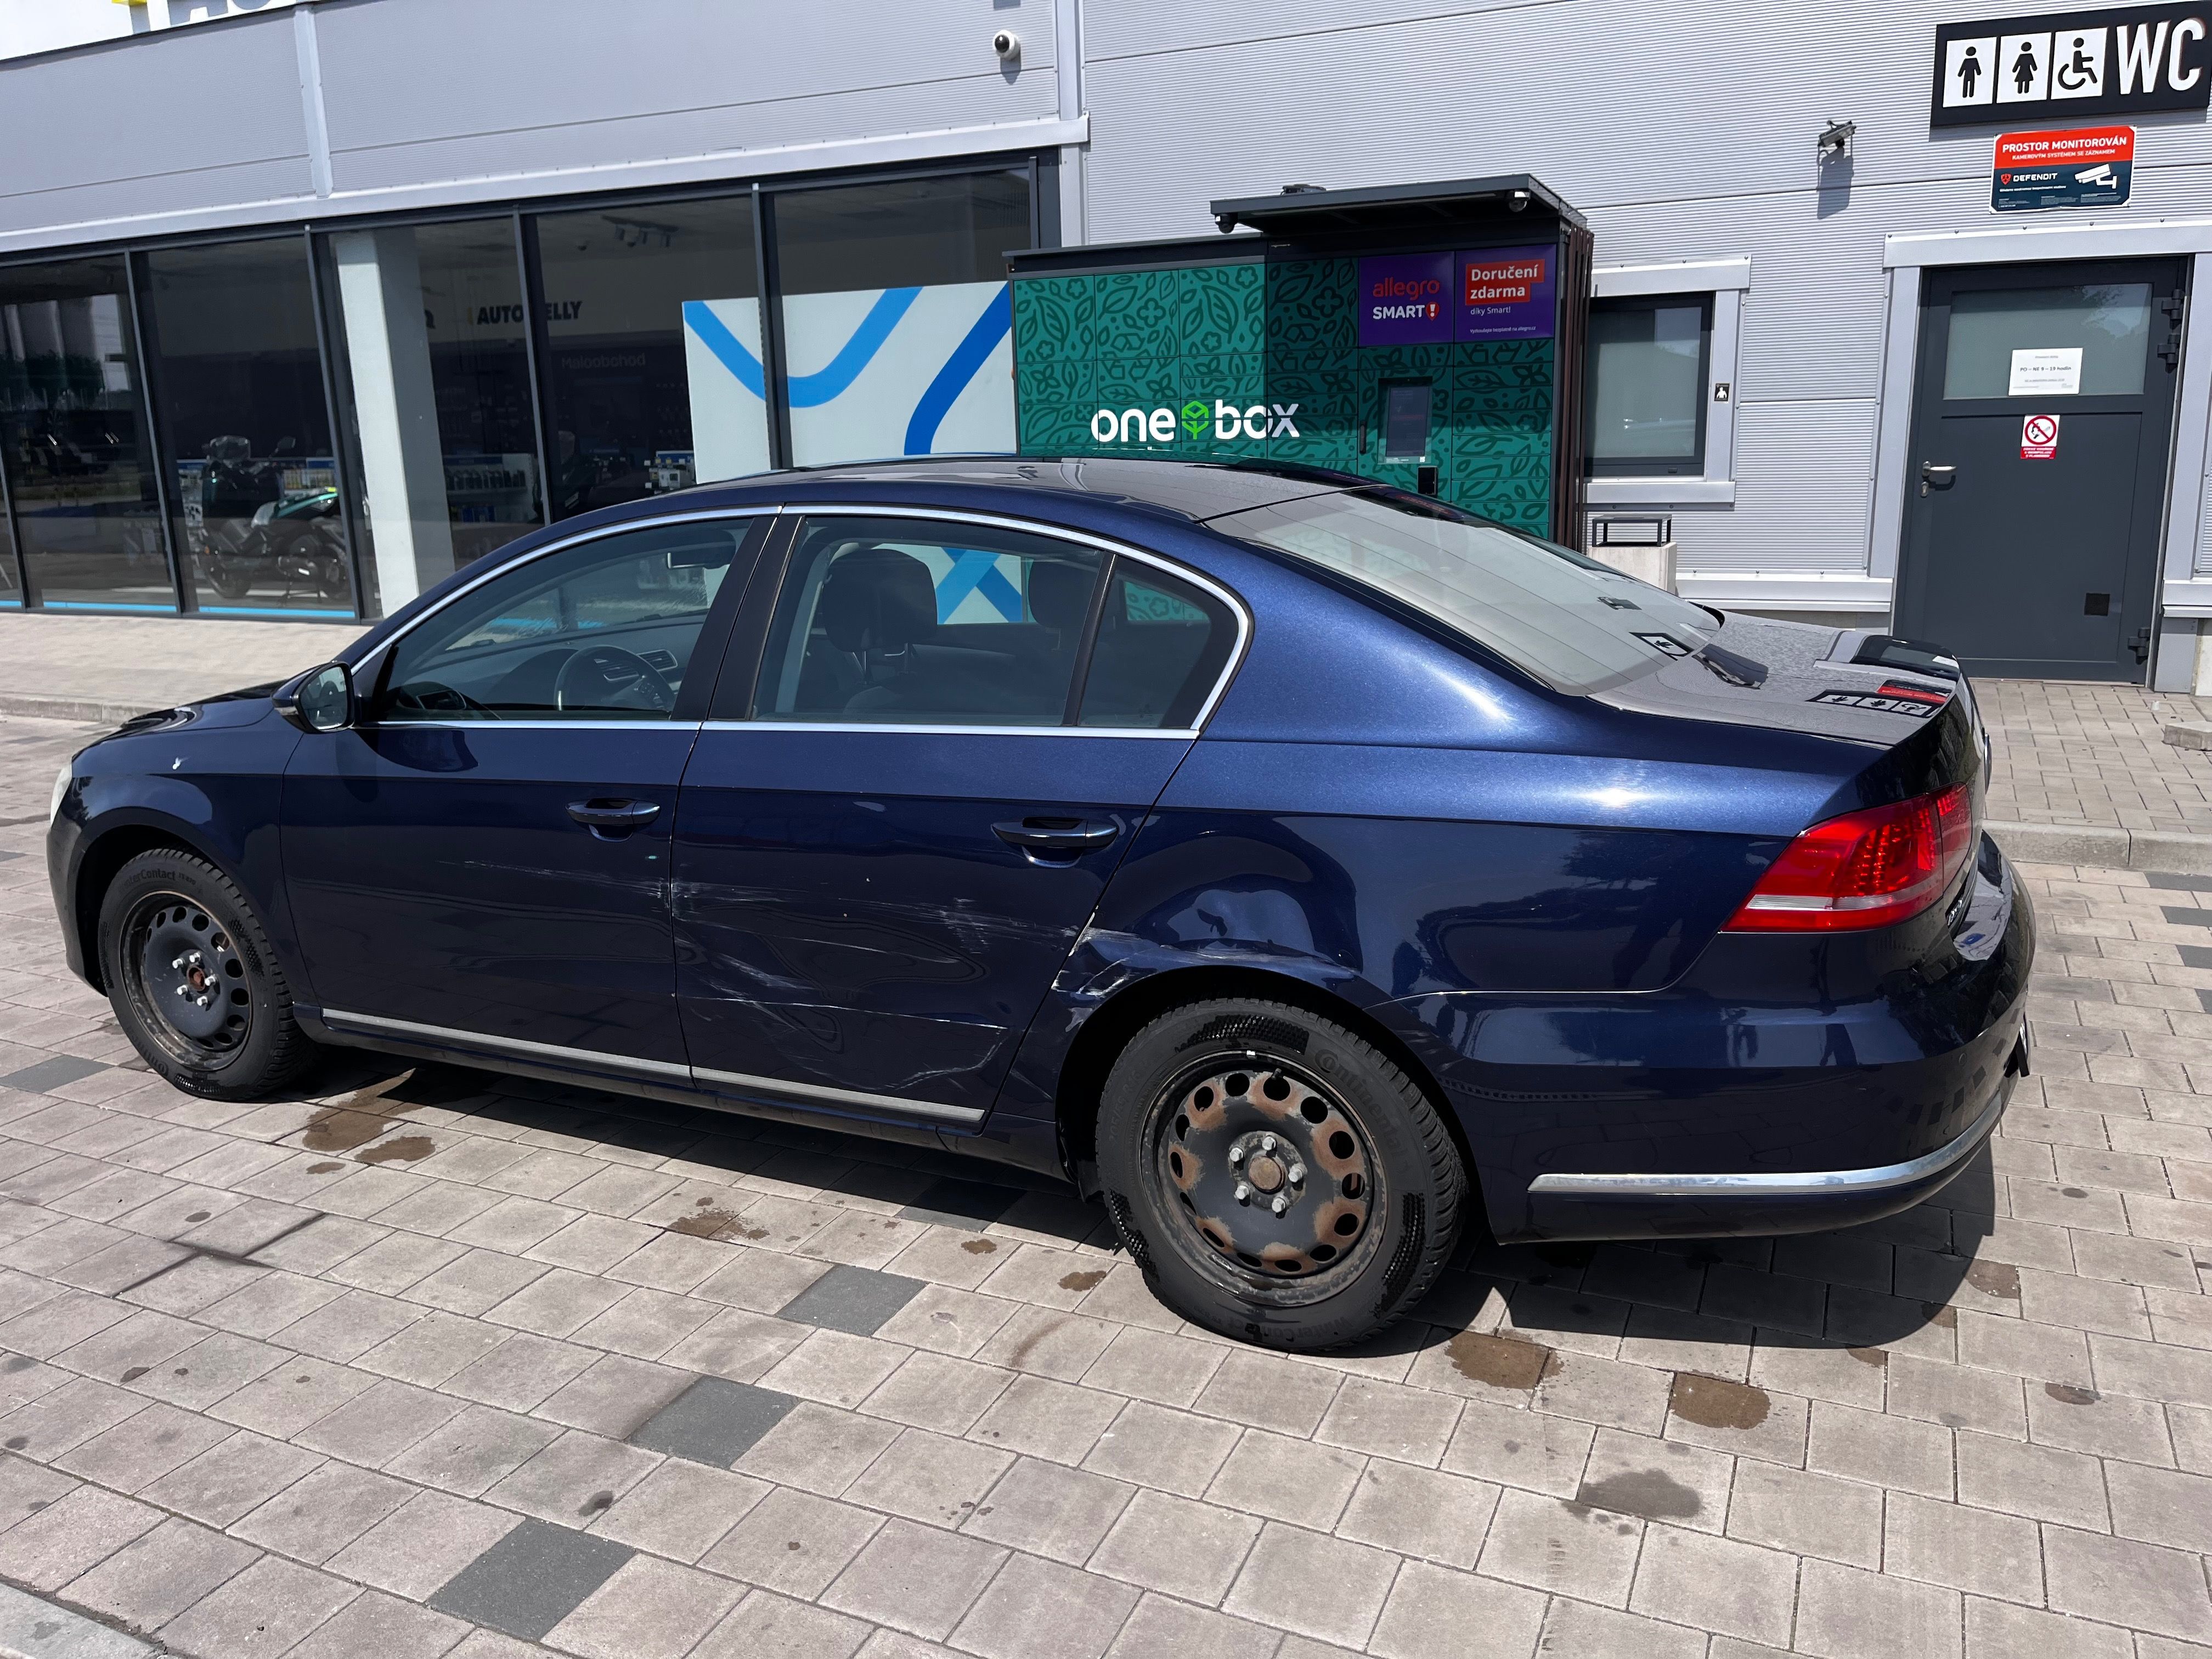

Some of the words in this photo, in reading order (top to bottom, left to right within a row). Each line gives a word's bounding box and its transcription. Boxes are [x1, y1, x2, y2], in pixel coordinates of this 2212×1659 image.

[2117, 18, 2206, 95] WC
[2002, 141, 2049, 153] PROSTOR
[2052, 135, 2127, 150] MONITOROVÁN
[2013, 173, 2058, 182] DEFENDIT
[1471, 264, 1538, 281] Doručení
[1373, 277, 1440, 301] allegro
[1470, 286, 1526, 300] zdarma
[477, 304, 524, 325] AUTO
[545, 300, 583, 320] ELLY
[1470, 307, 1486, 317] díky
[1487, 306, 1511, 314] Smart!
[561, 353, 646, 370] Maloobchod
[1091, 408, 1176, 443] one
[1215, 399, 1300, 439] box
